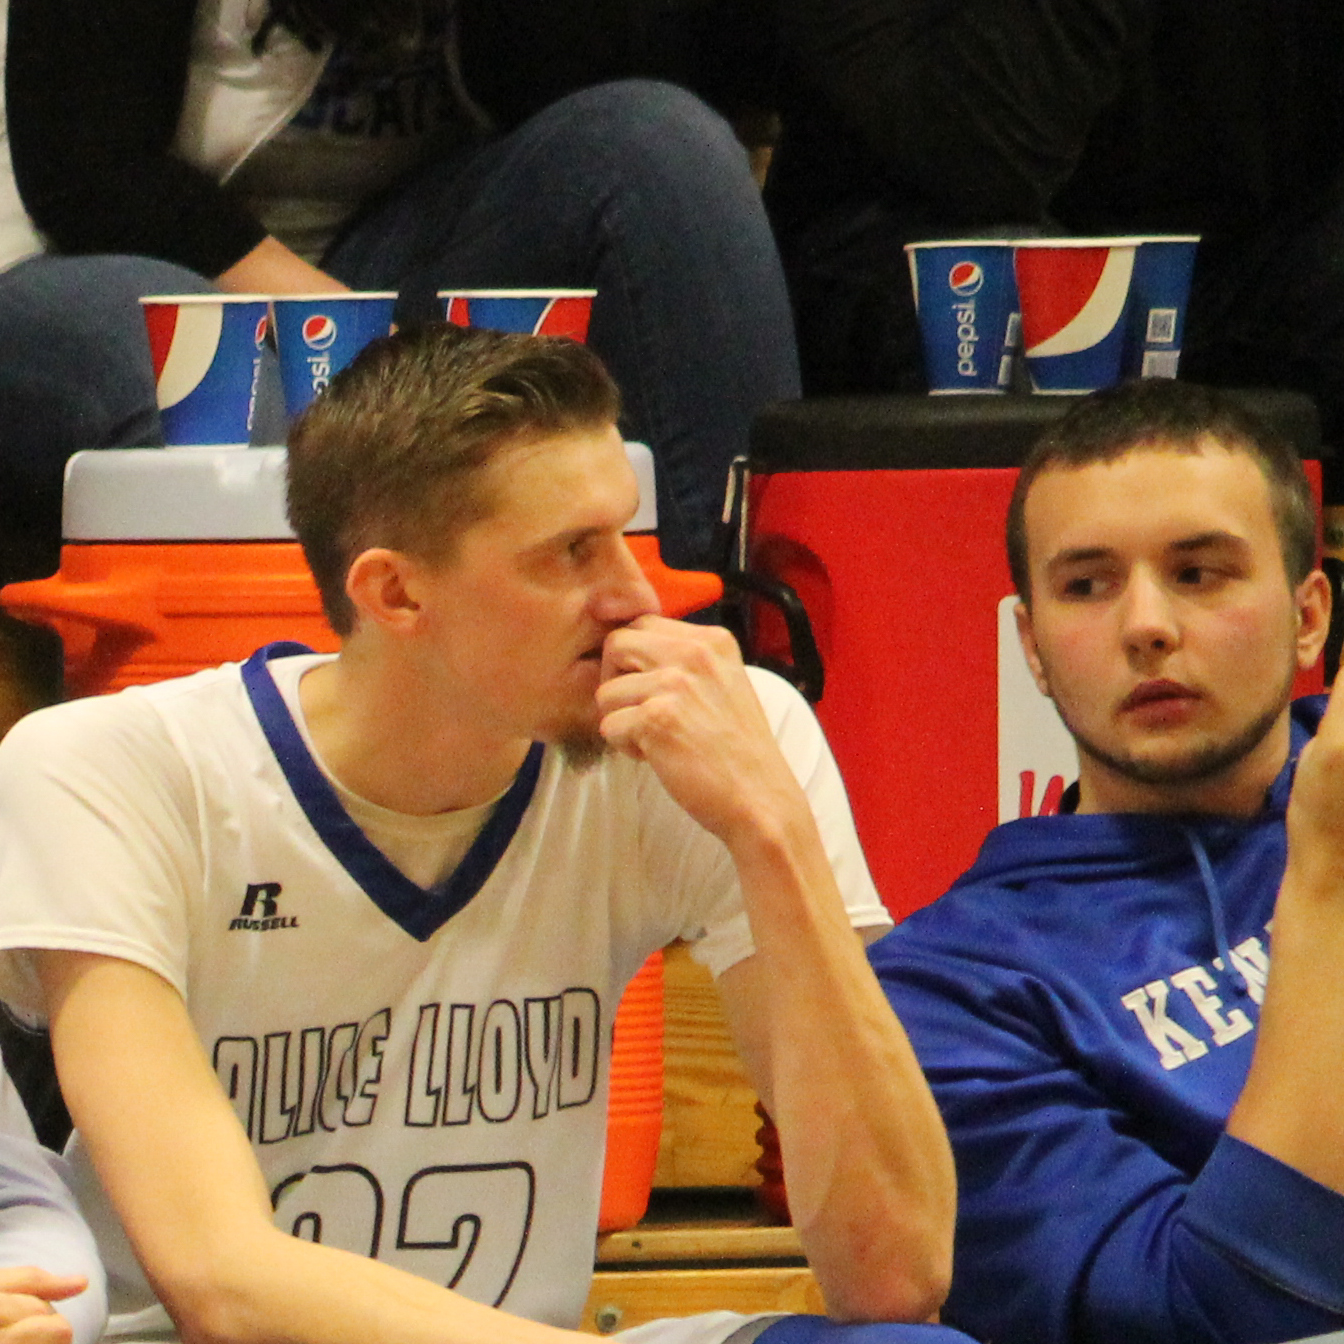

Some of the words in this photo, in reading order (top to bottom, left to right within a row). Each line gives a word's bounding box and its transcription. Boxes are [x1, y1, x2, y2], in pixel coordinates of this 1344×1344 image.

[951, 302, 978, 377] pepsi
[228, 916, 300, 931] RUSSELL
[1121, 922, 1273, 1071] KEN
[212, 1007, 391, 1144] ALICE
[404, 987, 601, 1127] LLOYD
